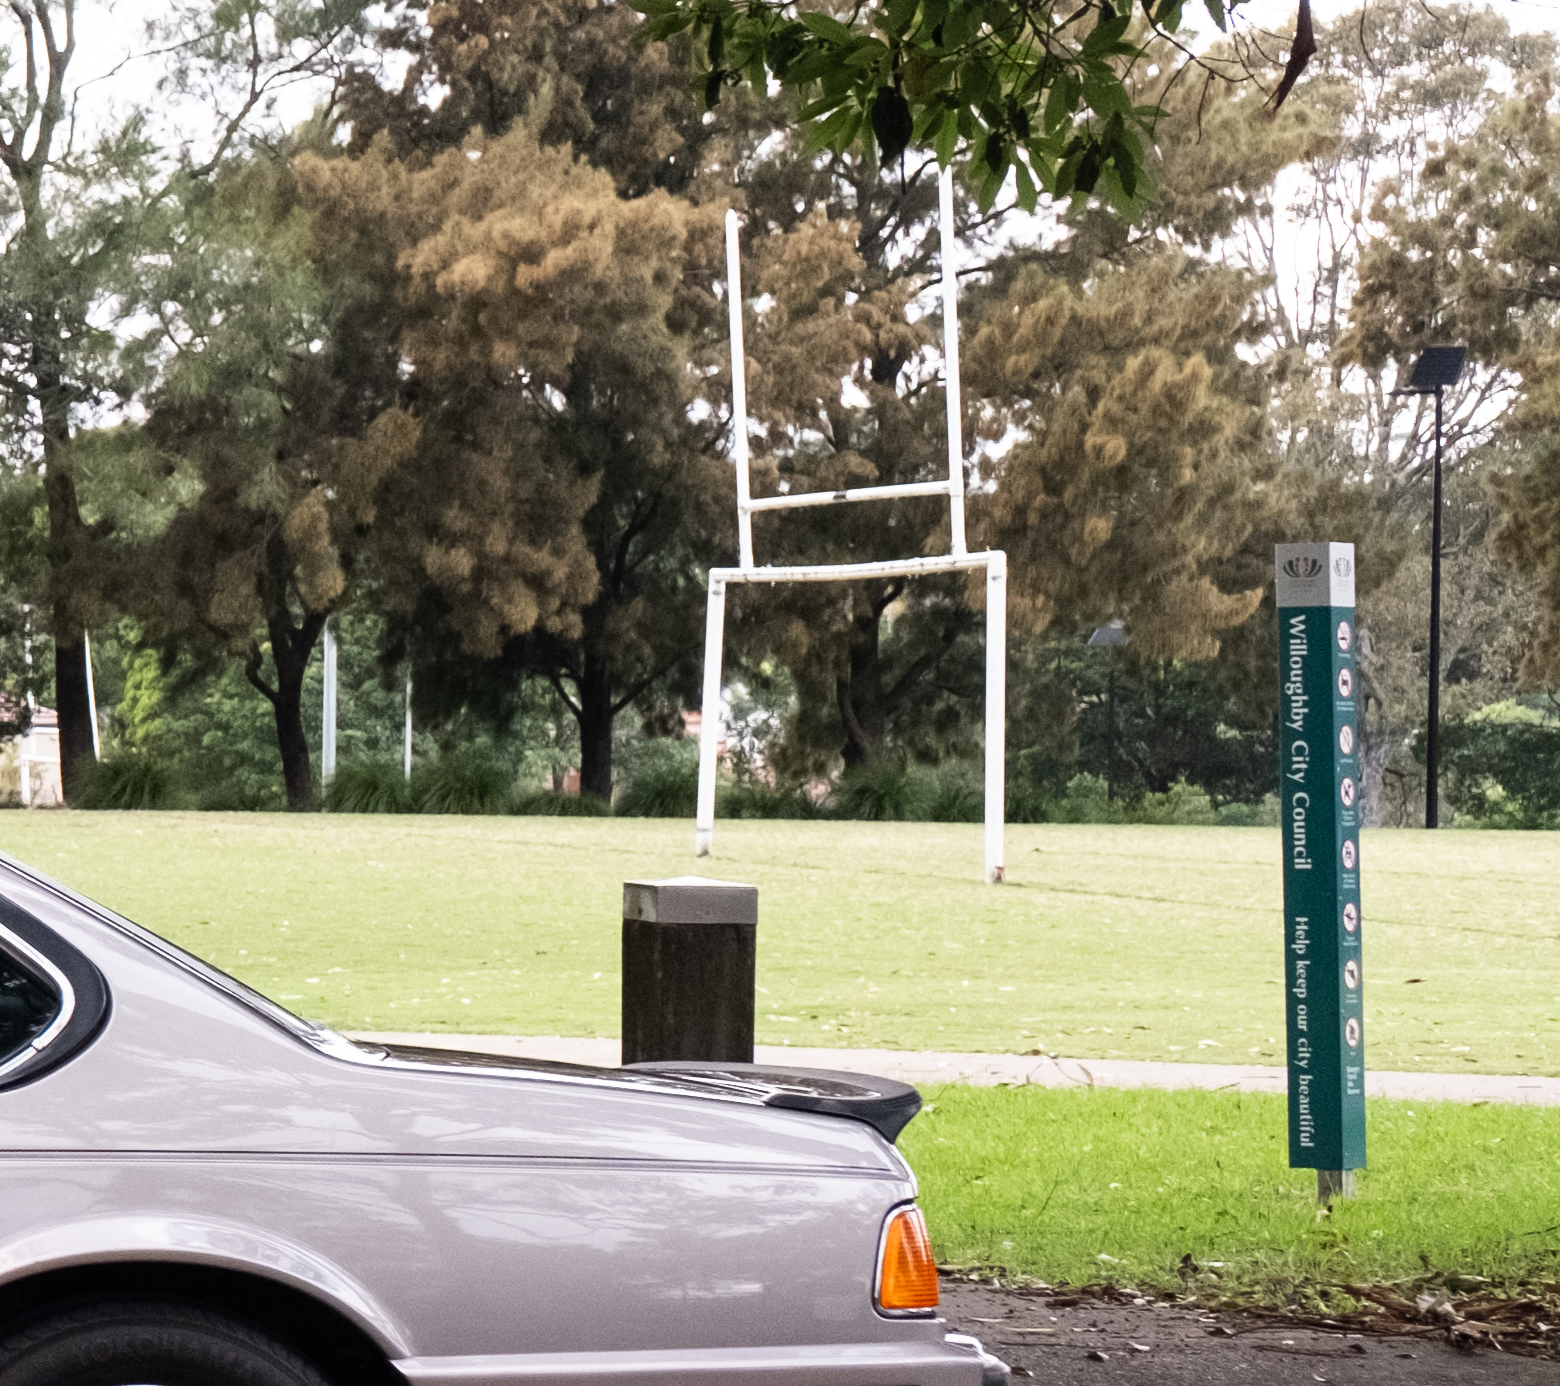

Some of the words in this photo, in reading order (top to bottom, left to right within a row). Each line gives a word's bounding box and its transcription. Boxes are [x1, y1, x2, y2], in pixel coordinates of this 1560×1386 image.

[1284, 614, 1309, 732] Willoughby
[1286, 740, 1310, 783] City
[1292, 792, 1312, 869] Council
[1291, 917, 1311, 955] Help
[1292, 960, 1311, 999] keep
[1297, 1004, 1308, 1031] our
[1293, 1038, 1312, 1068] city
[1299, 1074, 1315, 1147] beautiful
